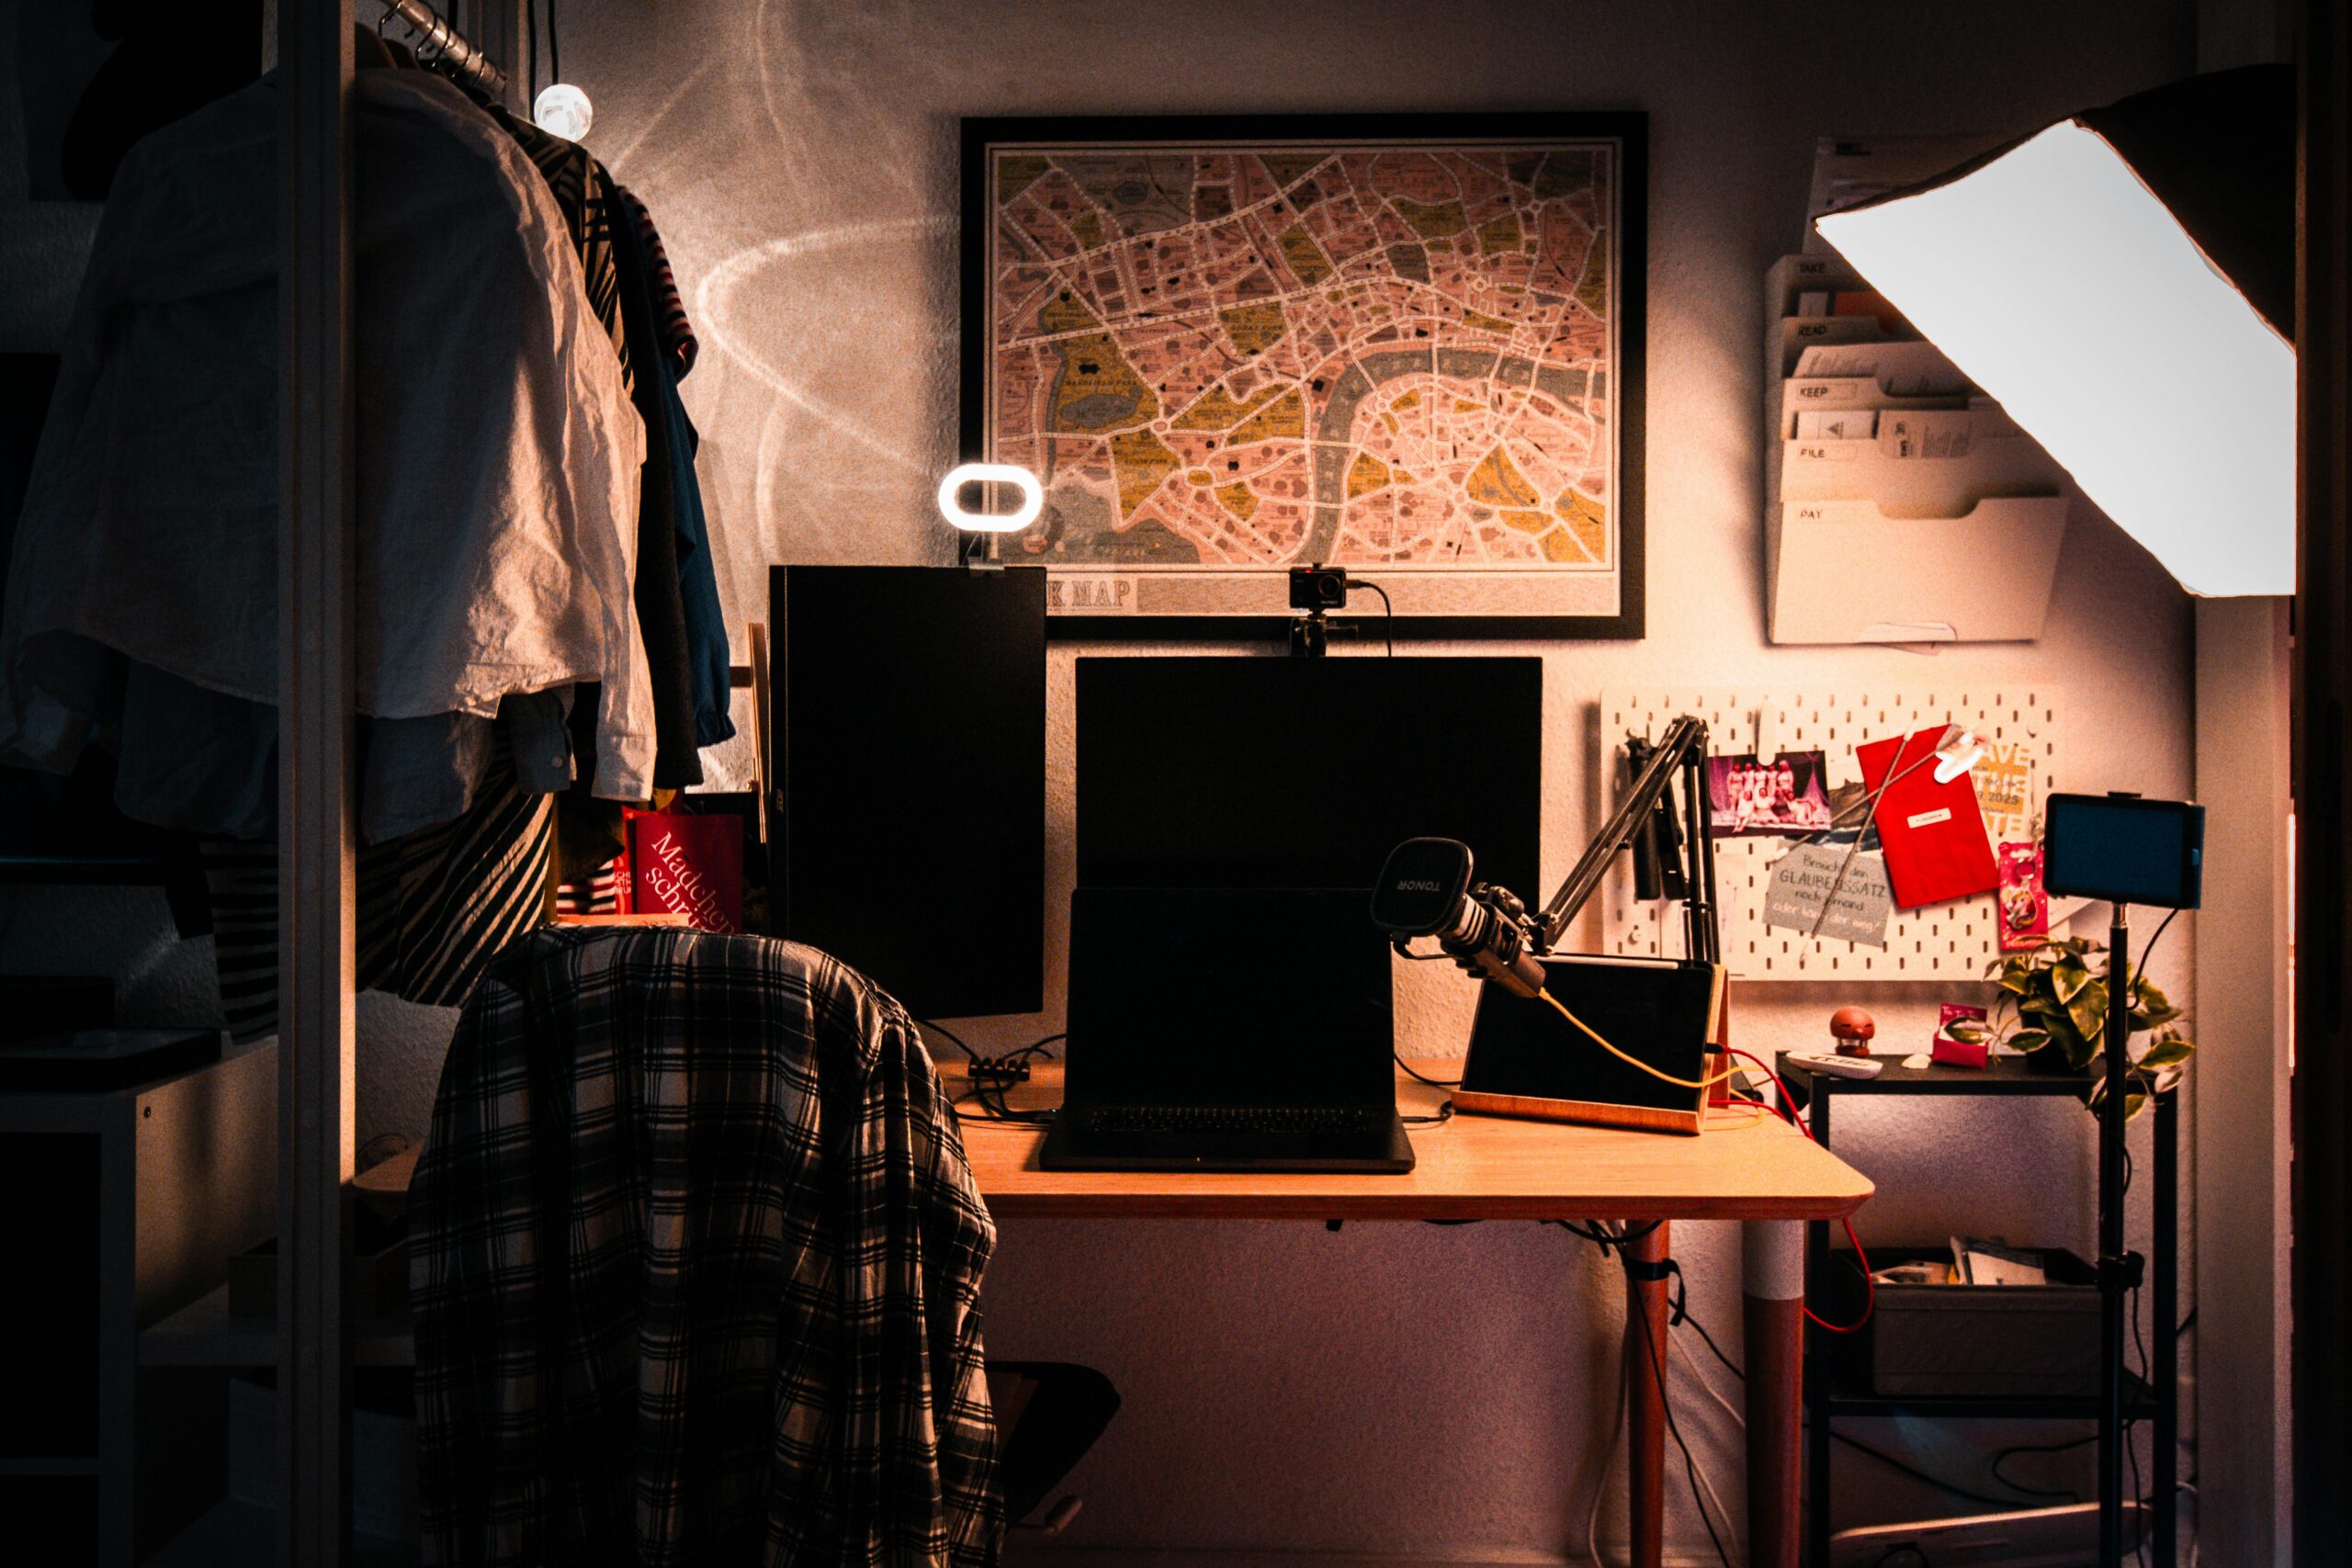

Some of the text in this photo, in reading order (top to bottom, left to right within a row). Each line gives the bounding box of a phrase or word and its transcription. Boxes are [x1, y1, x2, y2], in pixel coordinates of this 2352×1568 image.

[1798, 326, 1826, 336] READ
[1799, 387, 1828, 398] KEEP
[1800, 448, 1826, 458] FILE
[1800, 510, 1824, 520] PAY
[1046, 581, 1130, 607] K MAP
[1980, 744, 2030, 766] AVE
[1972, 770, 2027, 796] THE
[1803, 854, 1844, 872] Brauch
[1396, 880, 1441, 891] TONOR
